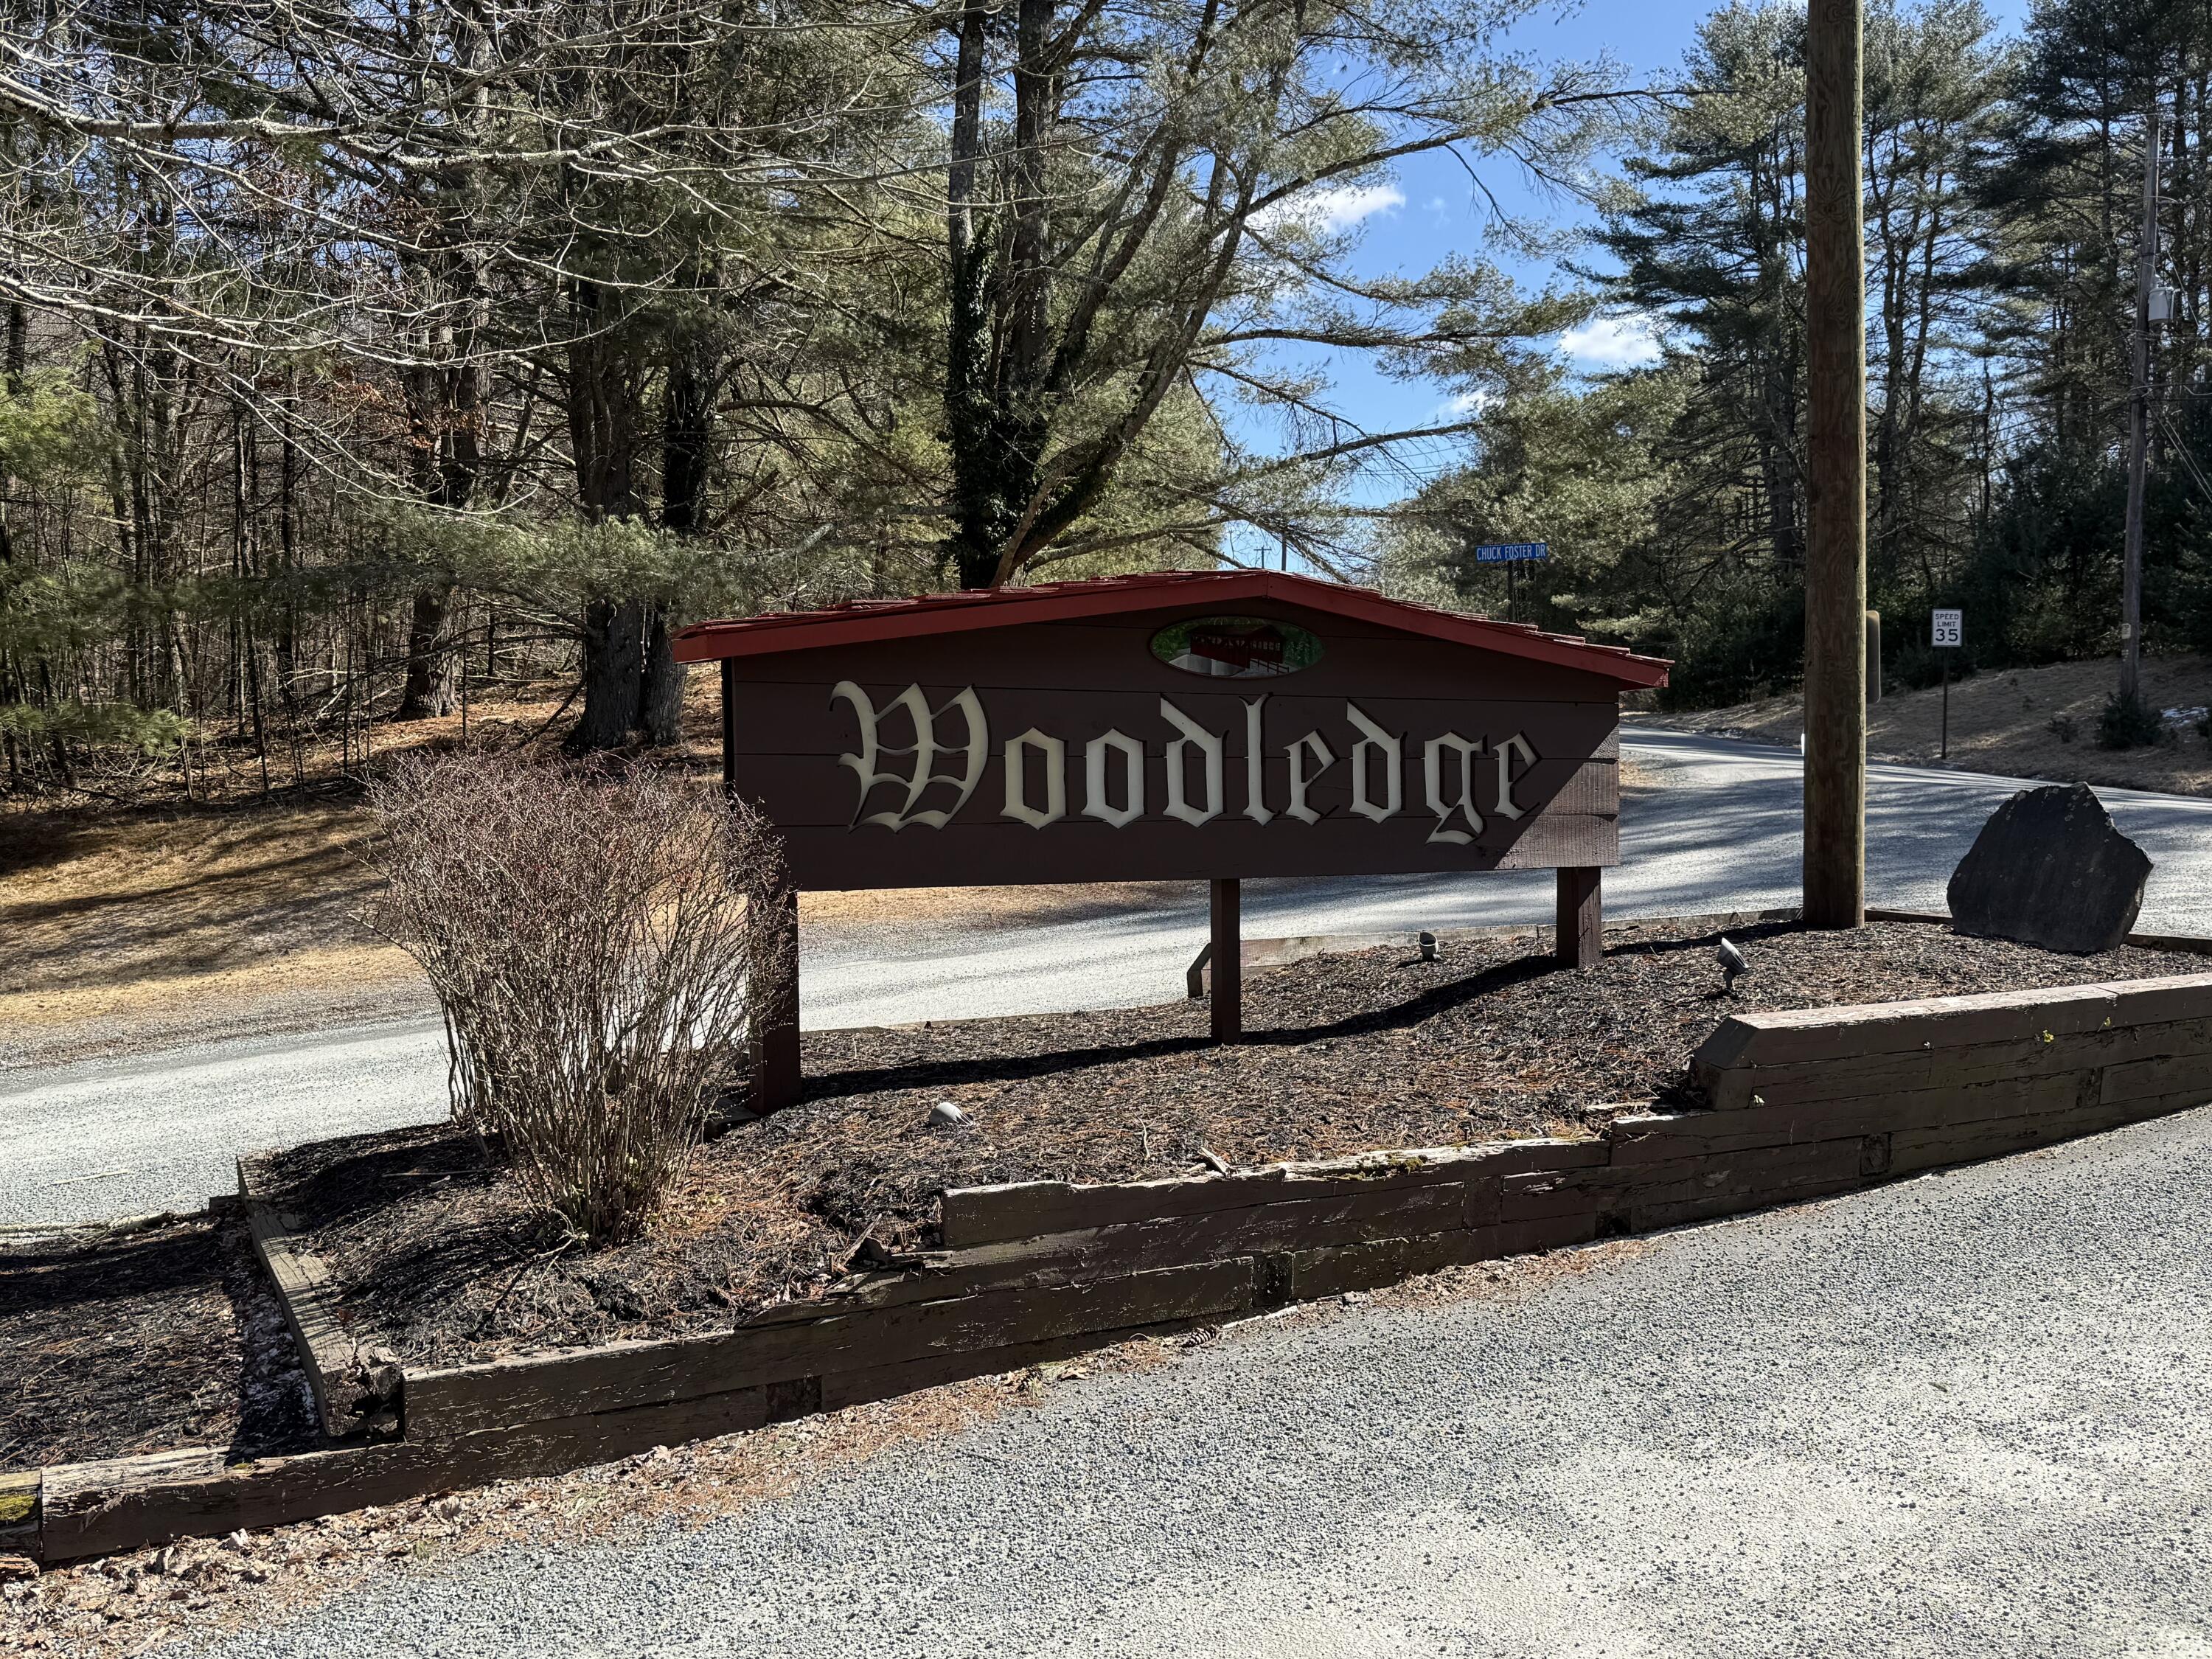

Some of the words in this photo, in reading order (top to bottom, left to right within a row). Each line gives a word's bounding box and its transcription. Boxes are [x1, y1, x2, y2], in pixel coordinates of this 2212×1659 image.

[1477, 546, 1502, 560] CHUCK
[1505, 545, 1531, 559] FOSTER
[1535, 544, 1545, 557] DR
[1935, 628, 1958, 641] 35
[830, 680, 1538, 846] Woodledge
